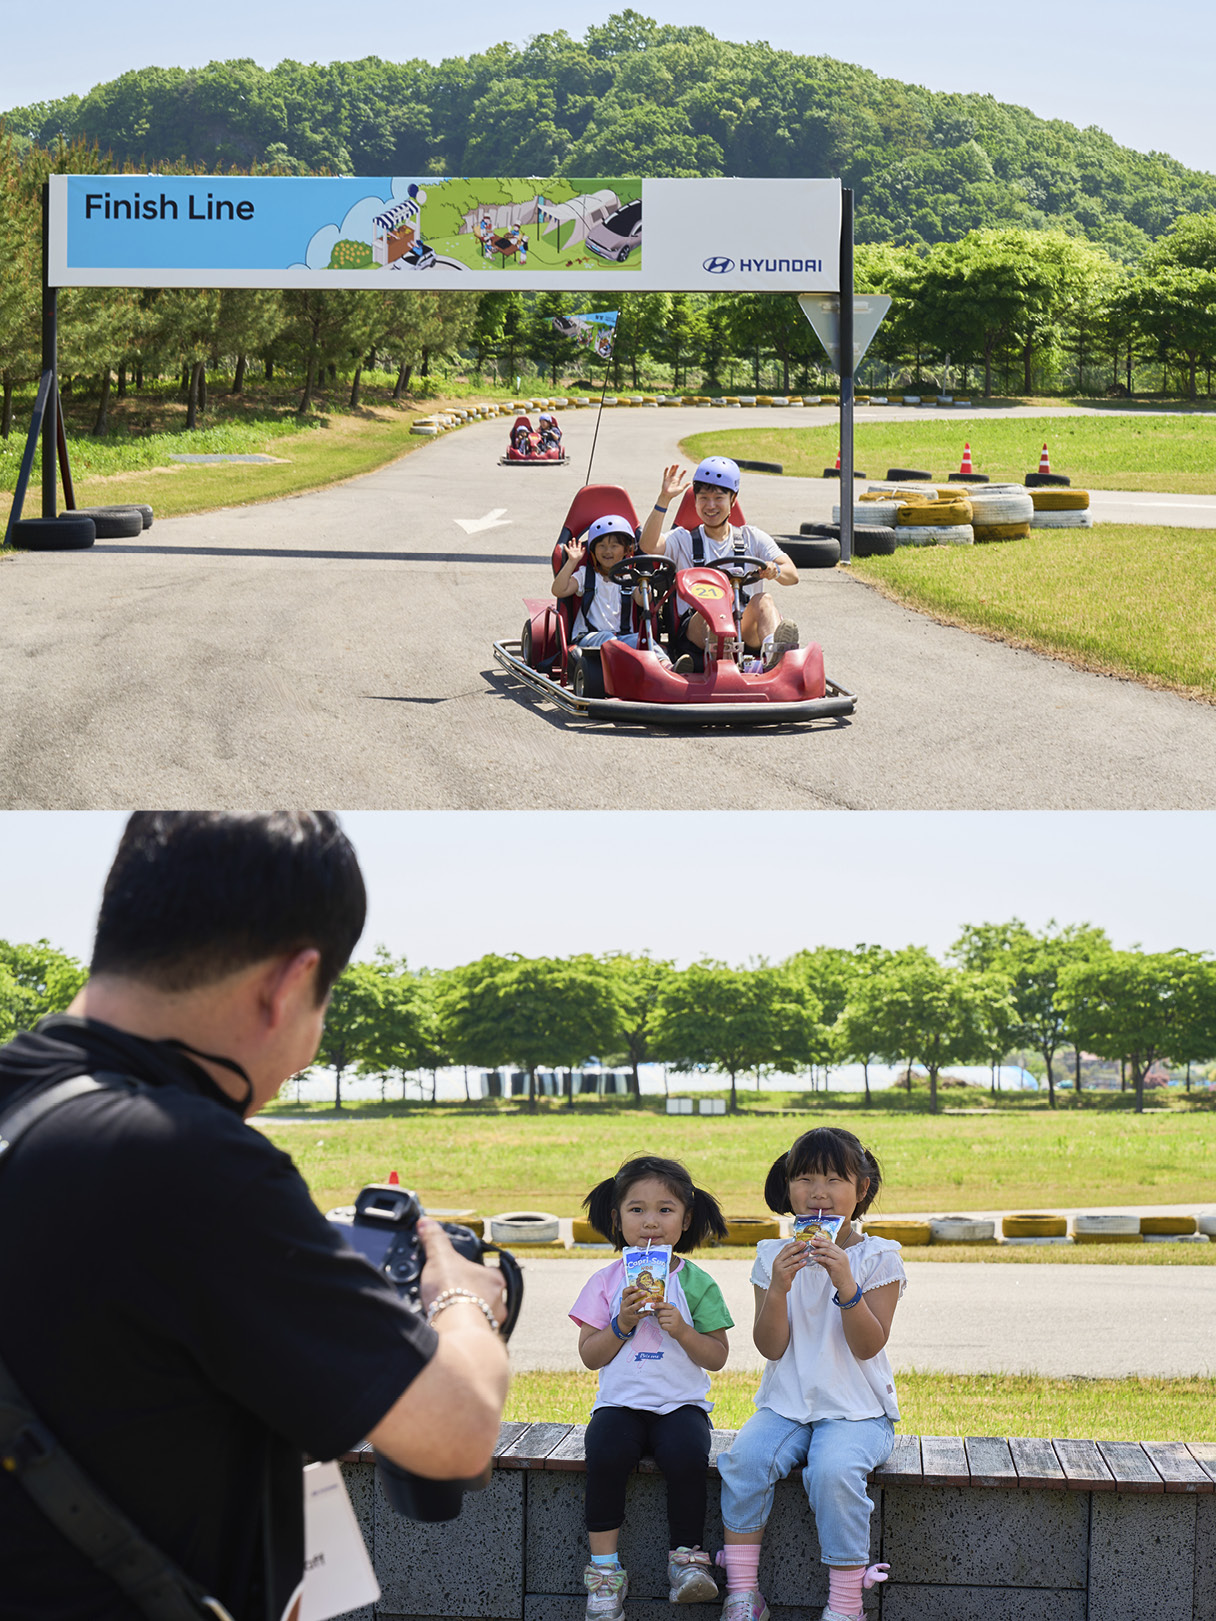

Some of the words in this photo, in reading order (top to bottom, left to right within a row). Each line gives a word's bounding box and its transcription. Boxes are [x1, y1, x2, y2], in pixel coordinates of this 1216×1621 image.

[86, 192, 178, 220] Finish
[189, 193, 255, 221] Line
[740, 259, 822, 272] HYUNDAI
[695, 587, 717, 597] 21
